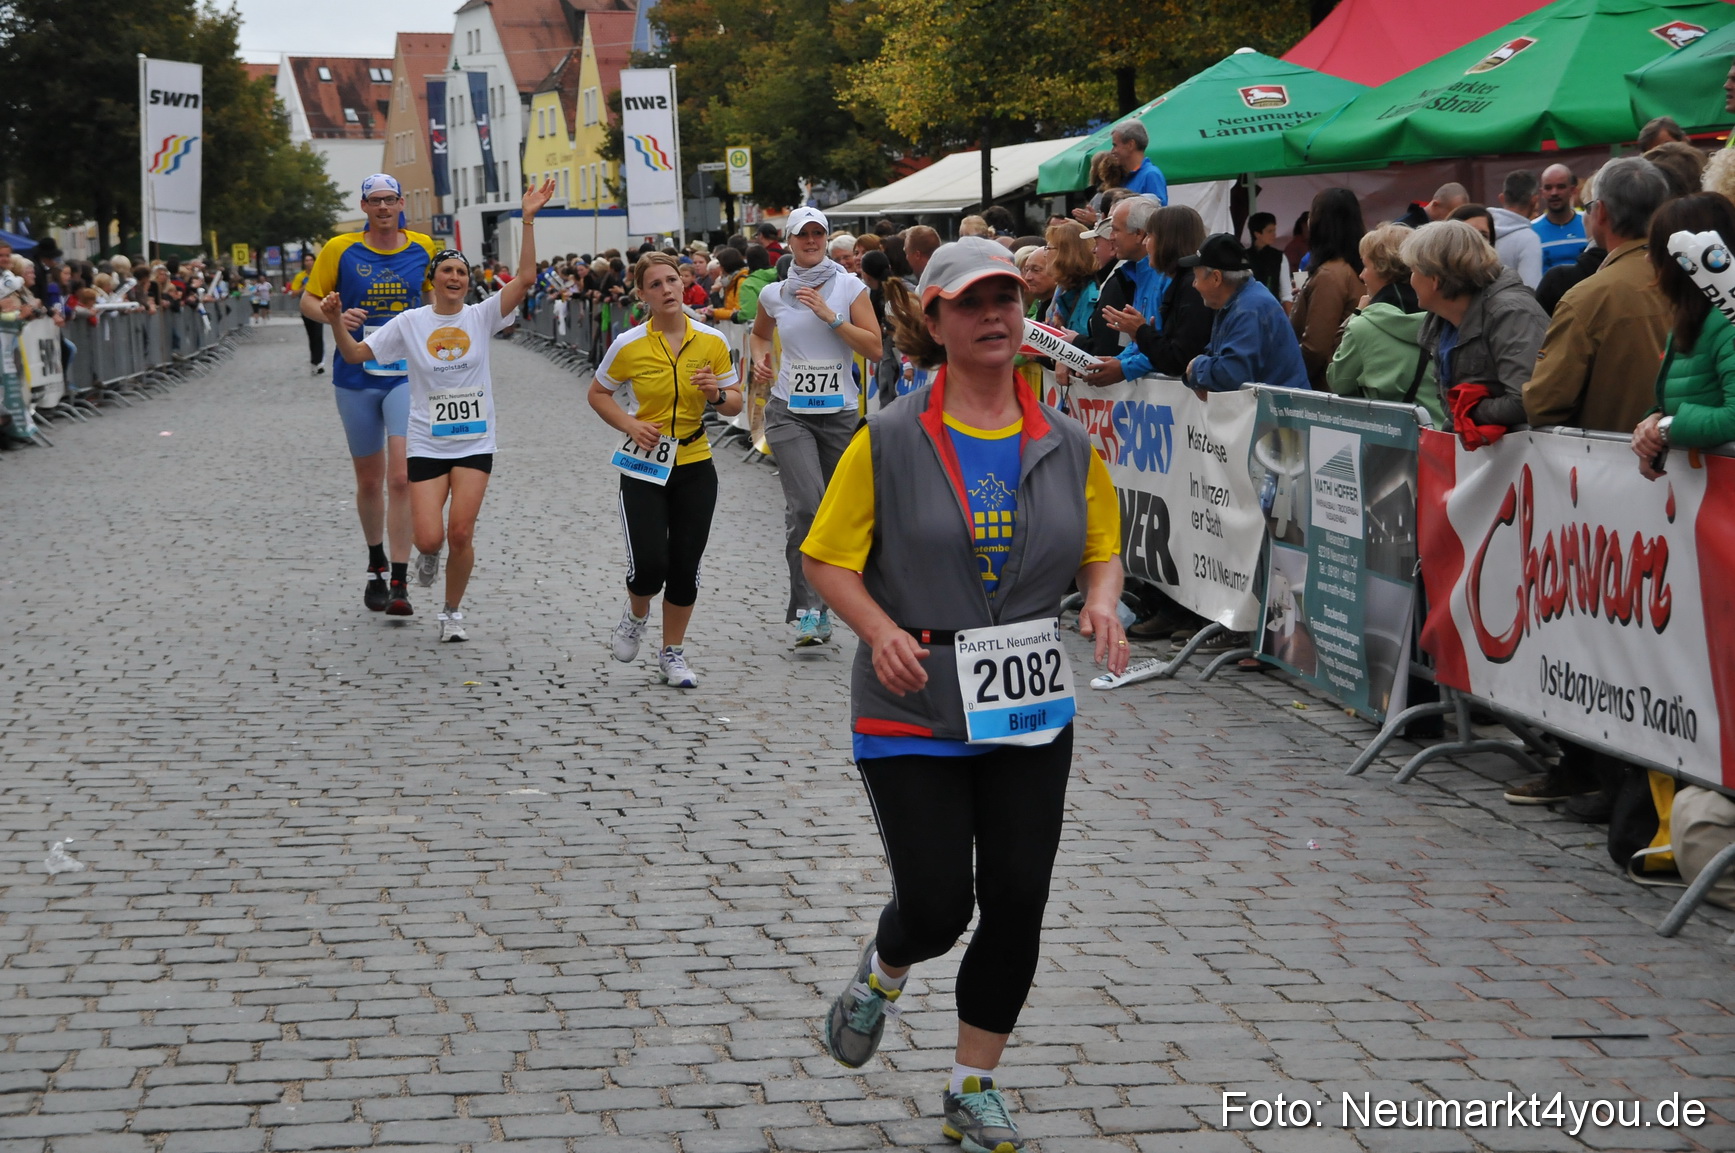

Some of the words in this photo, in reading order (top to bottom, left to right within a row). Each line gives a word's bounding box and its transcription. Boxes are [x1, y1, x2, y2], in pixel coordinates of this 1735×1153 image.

[149, 89, 199, 109] swn
[1217, 111, 1321, 126] Neumarkte
[1029, 328, 1060, 351] BMW
[434, 363, 468, 373] Ingolstadt
[795, 373, 839, 393] 2374
[449, 392, 476, 400] Neumarkt
[436, 400, 480, 422] 2091
[451, 425, 469, 434] Julia
[620, 457, 658, 475] Christiane
[1333, 483, 1358, 501] HOFFER
[1113, 486, 1180, 586] NER
[1465, 463, 1675, 664] Charivari
[959, 640, 1004, 653] PARTL
[1007, 632, 1051, 649] Neumarkt
[973, 648, 1065, 703] 2082
[1540, 655, 1634, 722] Ostbayerns
[1641, 686, 1697, 743] Radio
[1009, 709, 1047, 731] Birgit
